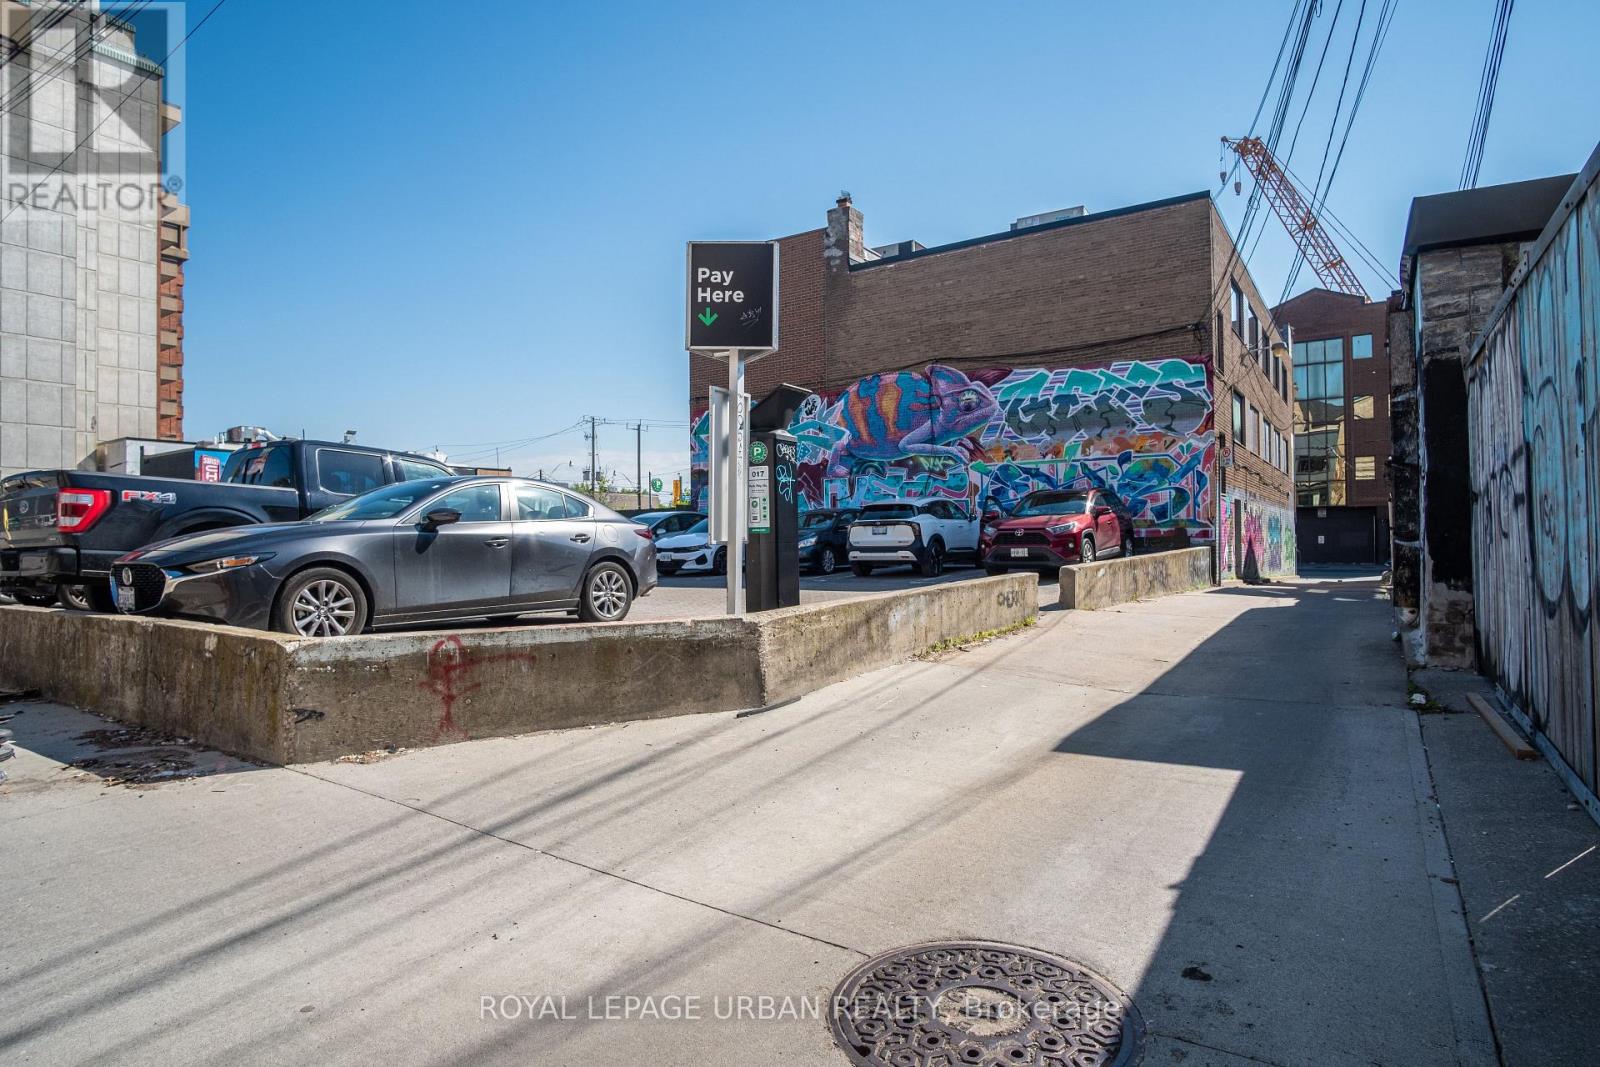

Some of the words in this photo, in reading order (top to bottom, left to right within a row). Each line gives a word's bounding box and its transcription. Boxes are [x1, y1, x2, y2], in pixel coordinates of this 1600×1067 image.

[698, 267, 734, 286] Pay
[698, 287, 745, 303] Here
[122, 490, 177, 504] FX4
